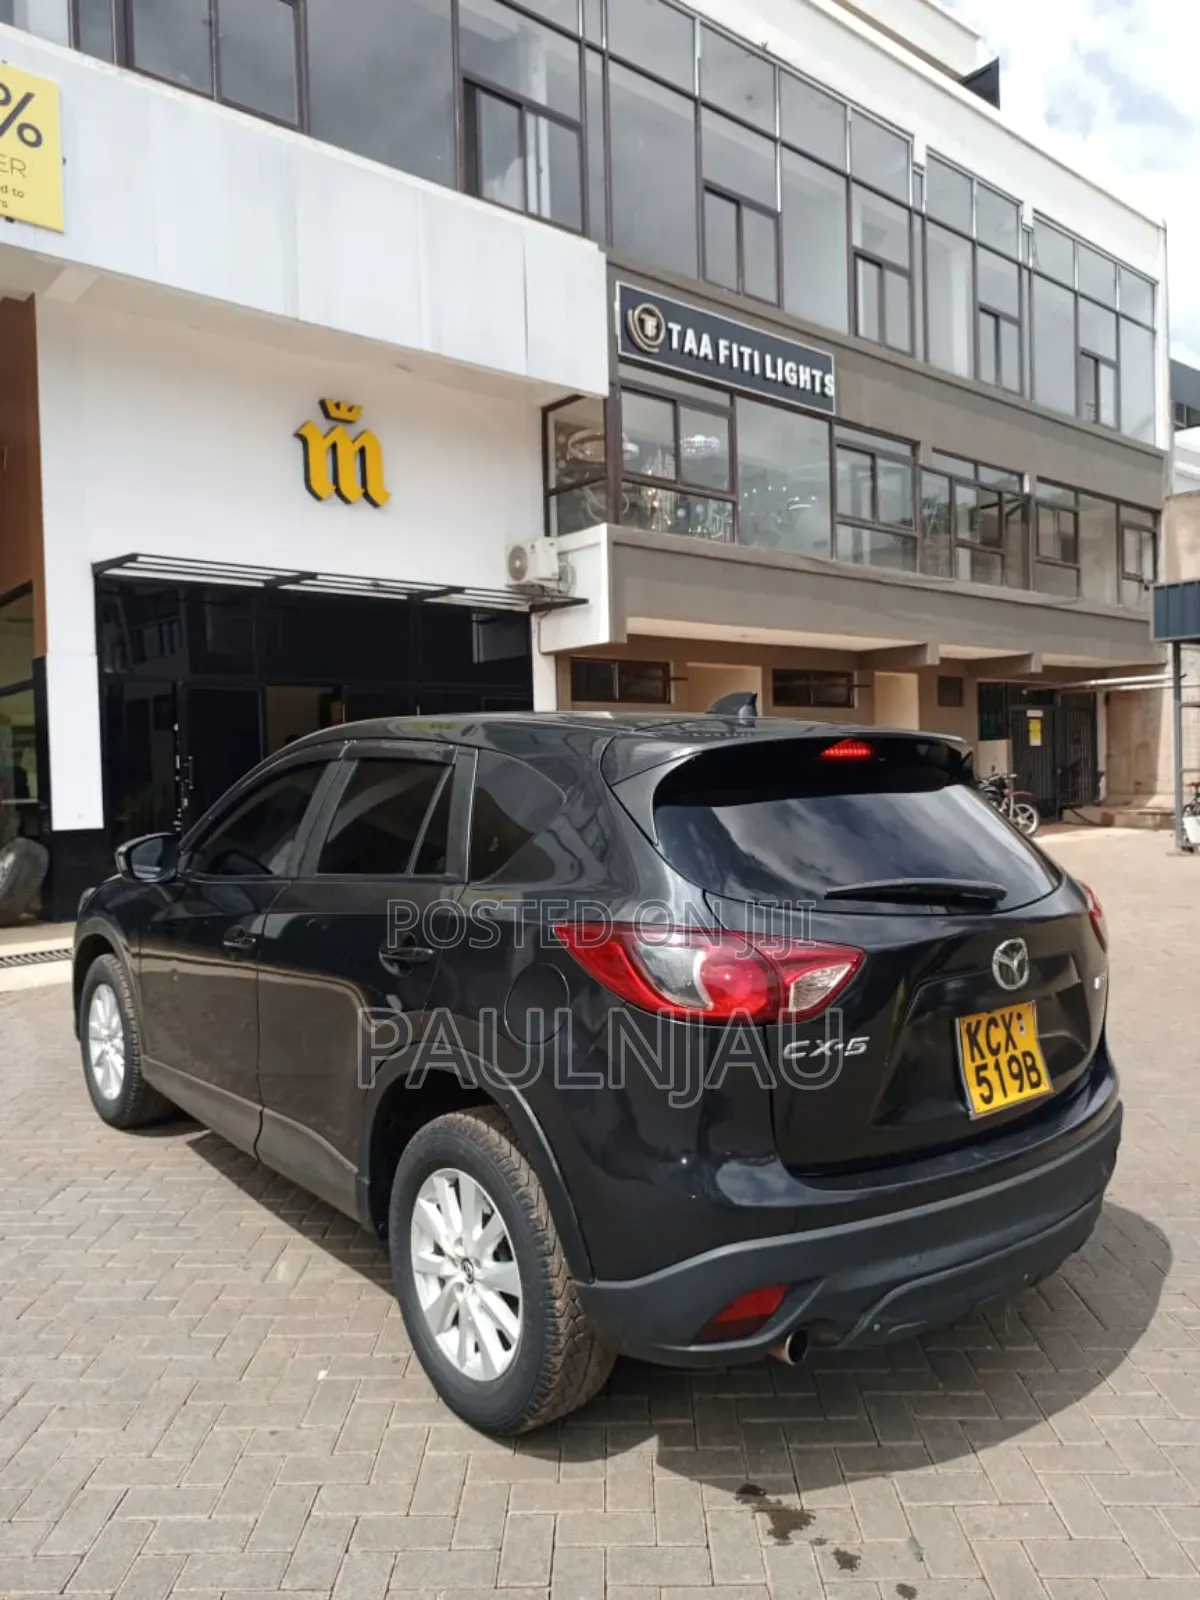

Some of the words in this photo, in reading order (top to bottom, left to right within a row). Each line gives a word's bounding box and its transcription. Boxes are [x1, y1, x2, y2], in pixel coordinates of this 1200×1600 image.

[667, 322, 714, 361] TAA
[718, 339, 760, 376] FITI
[764, 354, 835, 397] LIGHTS
[783, 1036, 870, 1059] CX-5
[966, 1011, 1018, 1063] KCX
[974, 1050, 1042, 1105] 519B
